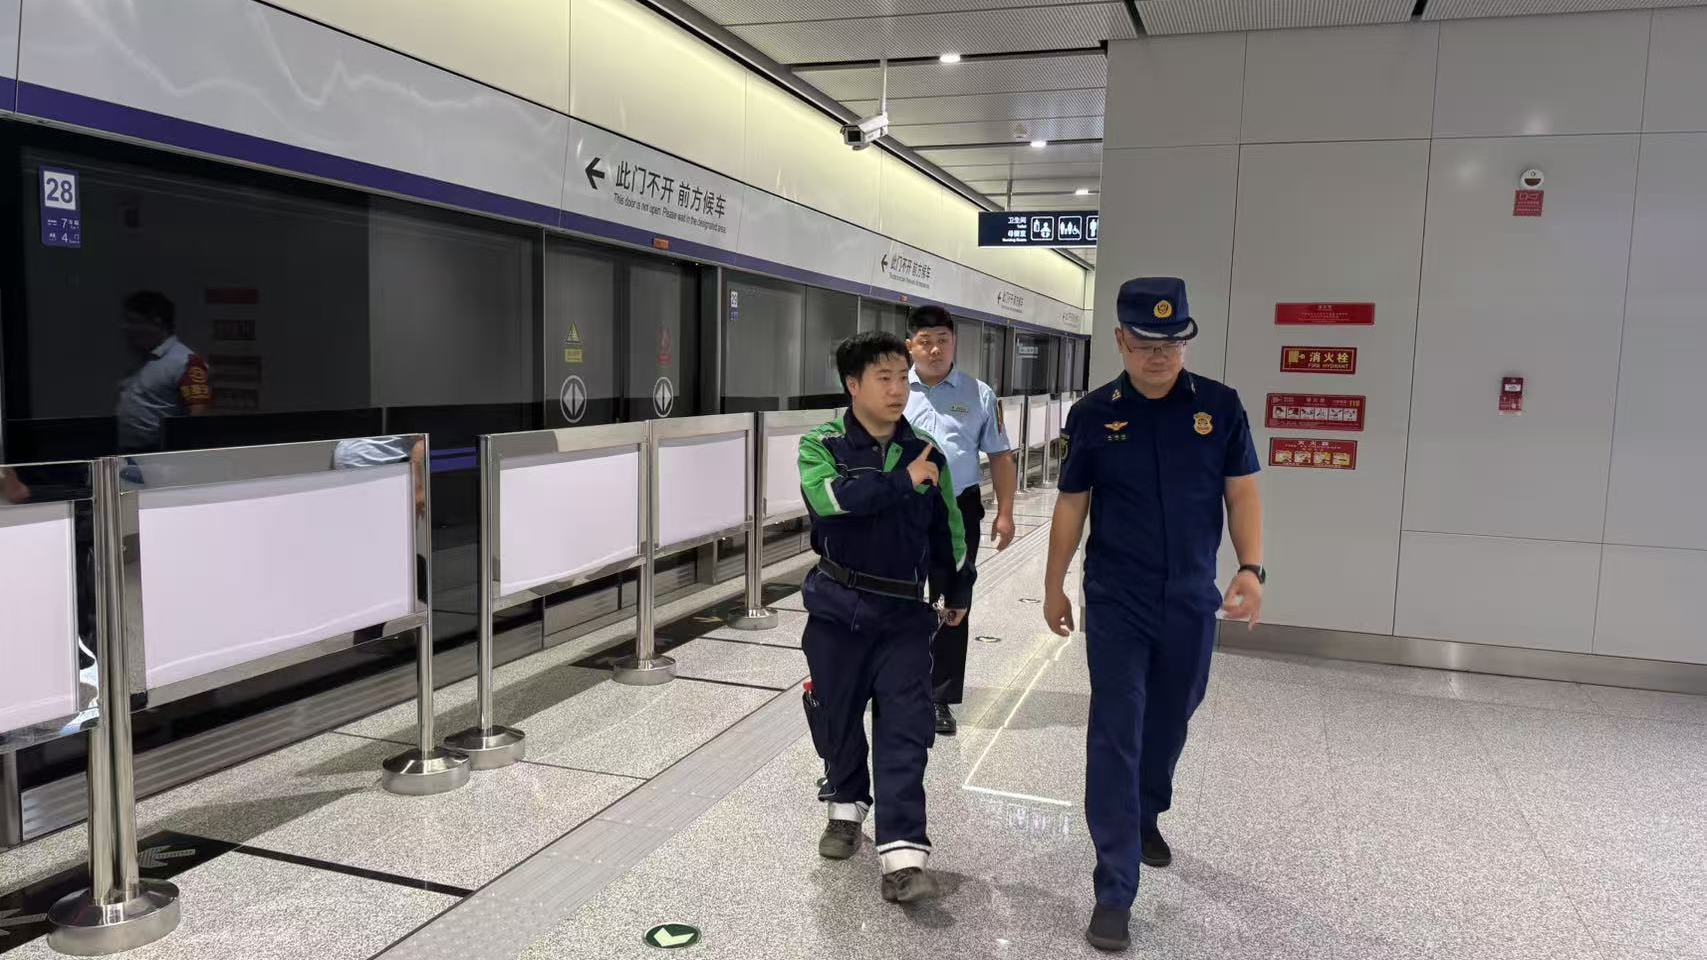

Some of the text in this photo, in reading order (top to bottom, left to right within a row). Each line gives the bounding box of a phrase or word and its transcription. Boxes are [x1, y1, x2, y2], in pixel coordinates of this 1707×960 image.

[46, 177, 73, 204] 28
[615, 160, 726, 218] 此门不开 前方候车
[614, 192, 624, 205] This
[625, 196, 636, 208] door
[61, 218, 68, 228] 7
[61, 233, 68, 243] 4
[1309, 352, 1349, 363] 消火栓
